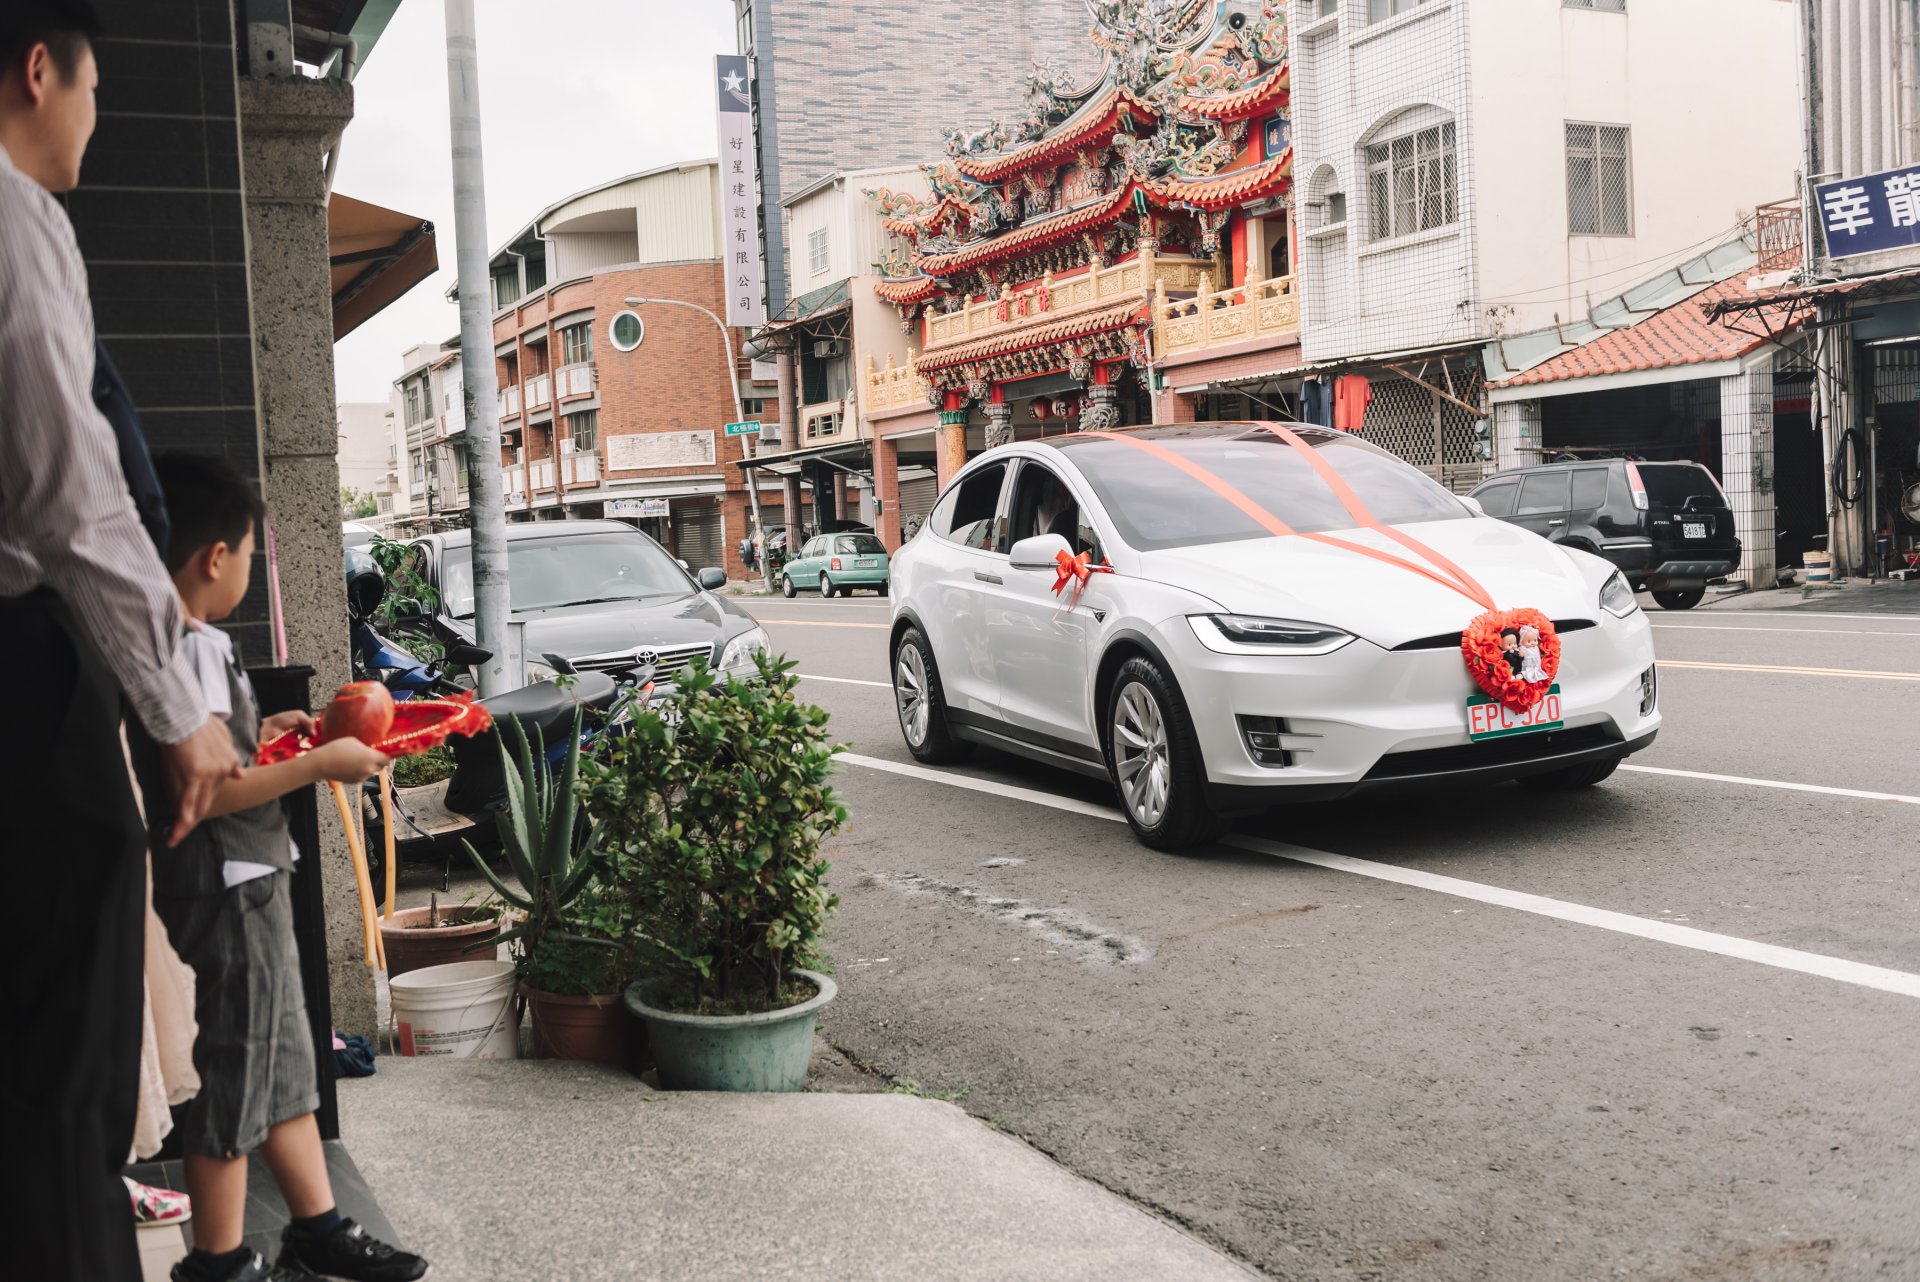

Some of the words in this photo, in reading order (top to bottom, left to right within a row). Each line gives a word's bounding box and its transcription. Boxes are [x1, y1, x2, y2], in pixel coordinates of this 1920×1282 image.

[729, 137, 751, 311] 好星建設有限公司
